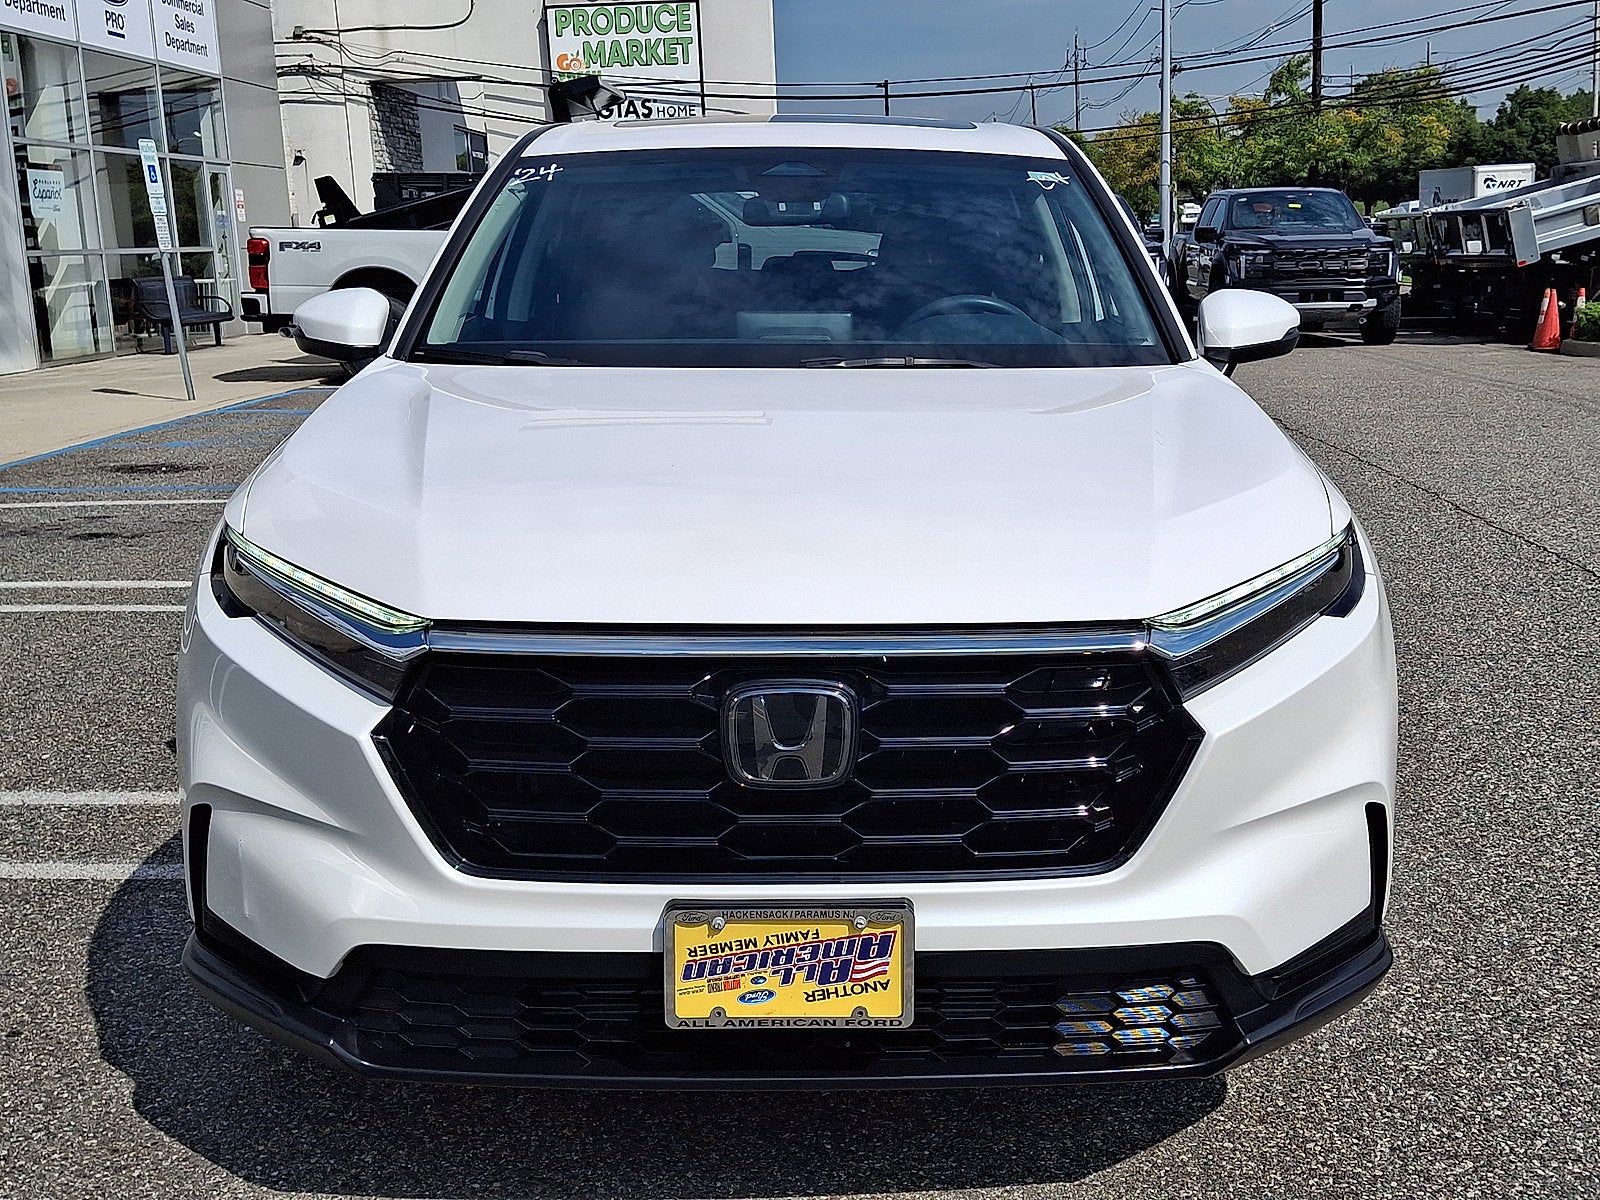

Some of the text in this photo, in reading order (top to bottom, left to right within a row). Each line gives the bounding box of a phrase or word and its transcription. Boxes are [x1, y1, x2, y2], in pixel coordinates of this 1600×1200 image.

[161, 0, 205, 16] ommercial
[104, 9, 125, 31] PRO
[174, 13, 195, 34] Sales
[554, 3, 693, 37] PRODUCE
[164, 31, 209, 57] Department
[582, 36, 694, 69] MARKET
[656, 105, 697, 118] HOME
[1497, 179, 1527, 189] NRT
[278, 240, 322, 252] FX4
[686, 928, 821, 958] FAMILY MEMBER
[769, 957, 855, 987] ALL
[803, 978, 891, 1003] ANOTHER
[676, 1019, 903, 1028] ALL AMERICAN FORD
